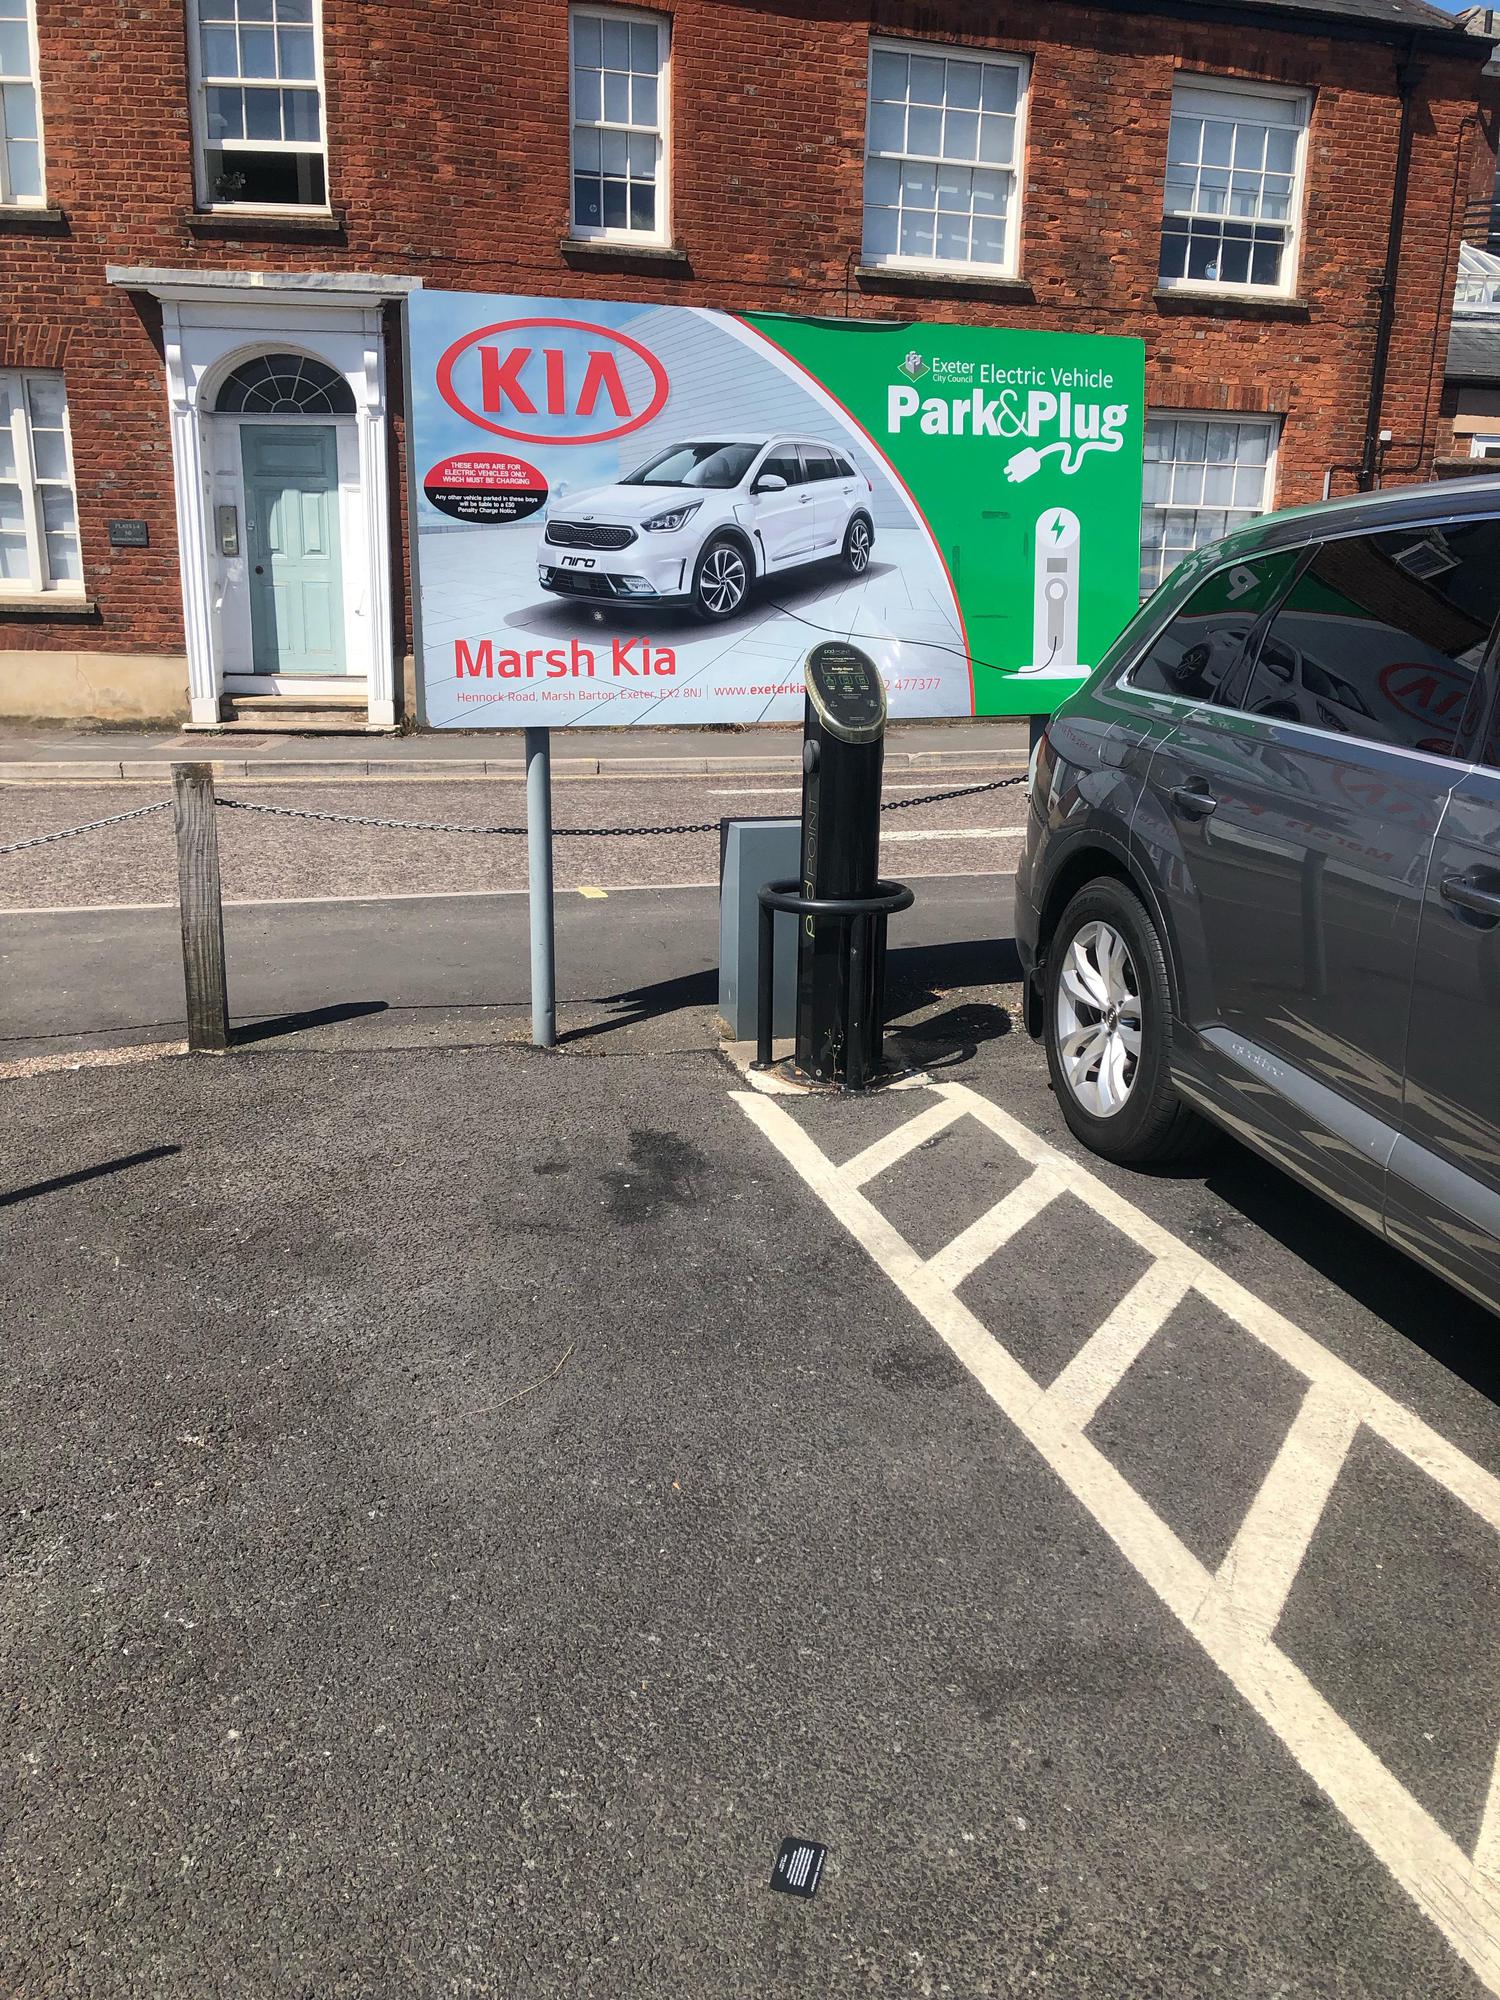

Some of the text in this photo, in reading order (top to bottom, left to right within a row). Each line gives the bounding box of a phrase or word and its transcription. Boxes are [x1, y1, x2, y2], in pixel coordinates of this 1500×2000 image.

[932, 357, 975, 374] Exeter
[477, 346, 632, 417] KIA
[932, 374, 974, 384] City Council
[980, 364, 1114, 389] Electric Vehicle
[888, 385, 1129, 444] Park&Plug
[442, 475, 465, 483] WHICH
[496, 477, 530, 485] CHARGING
[478, 469, 509, 477] VEHICLES
[457, 506, 478, 514] Penalty
[479, 507, 499, 515] Charge
[561, 556, 596, 568] niro
[454, 638, 676, 678] Marsh Kia
[457, 691, 504, 702] Hennock
[508, 691, 538, 703] Road,
[542, 690, 575, 702] Marsh
[578, 689, 618, 702] Barton,
[659, 688, 680, 699] EX2
[683, 687, 702, 698] 8NJ
[895, 678, 942, 690] 477377
